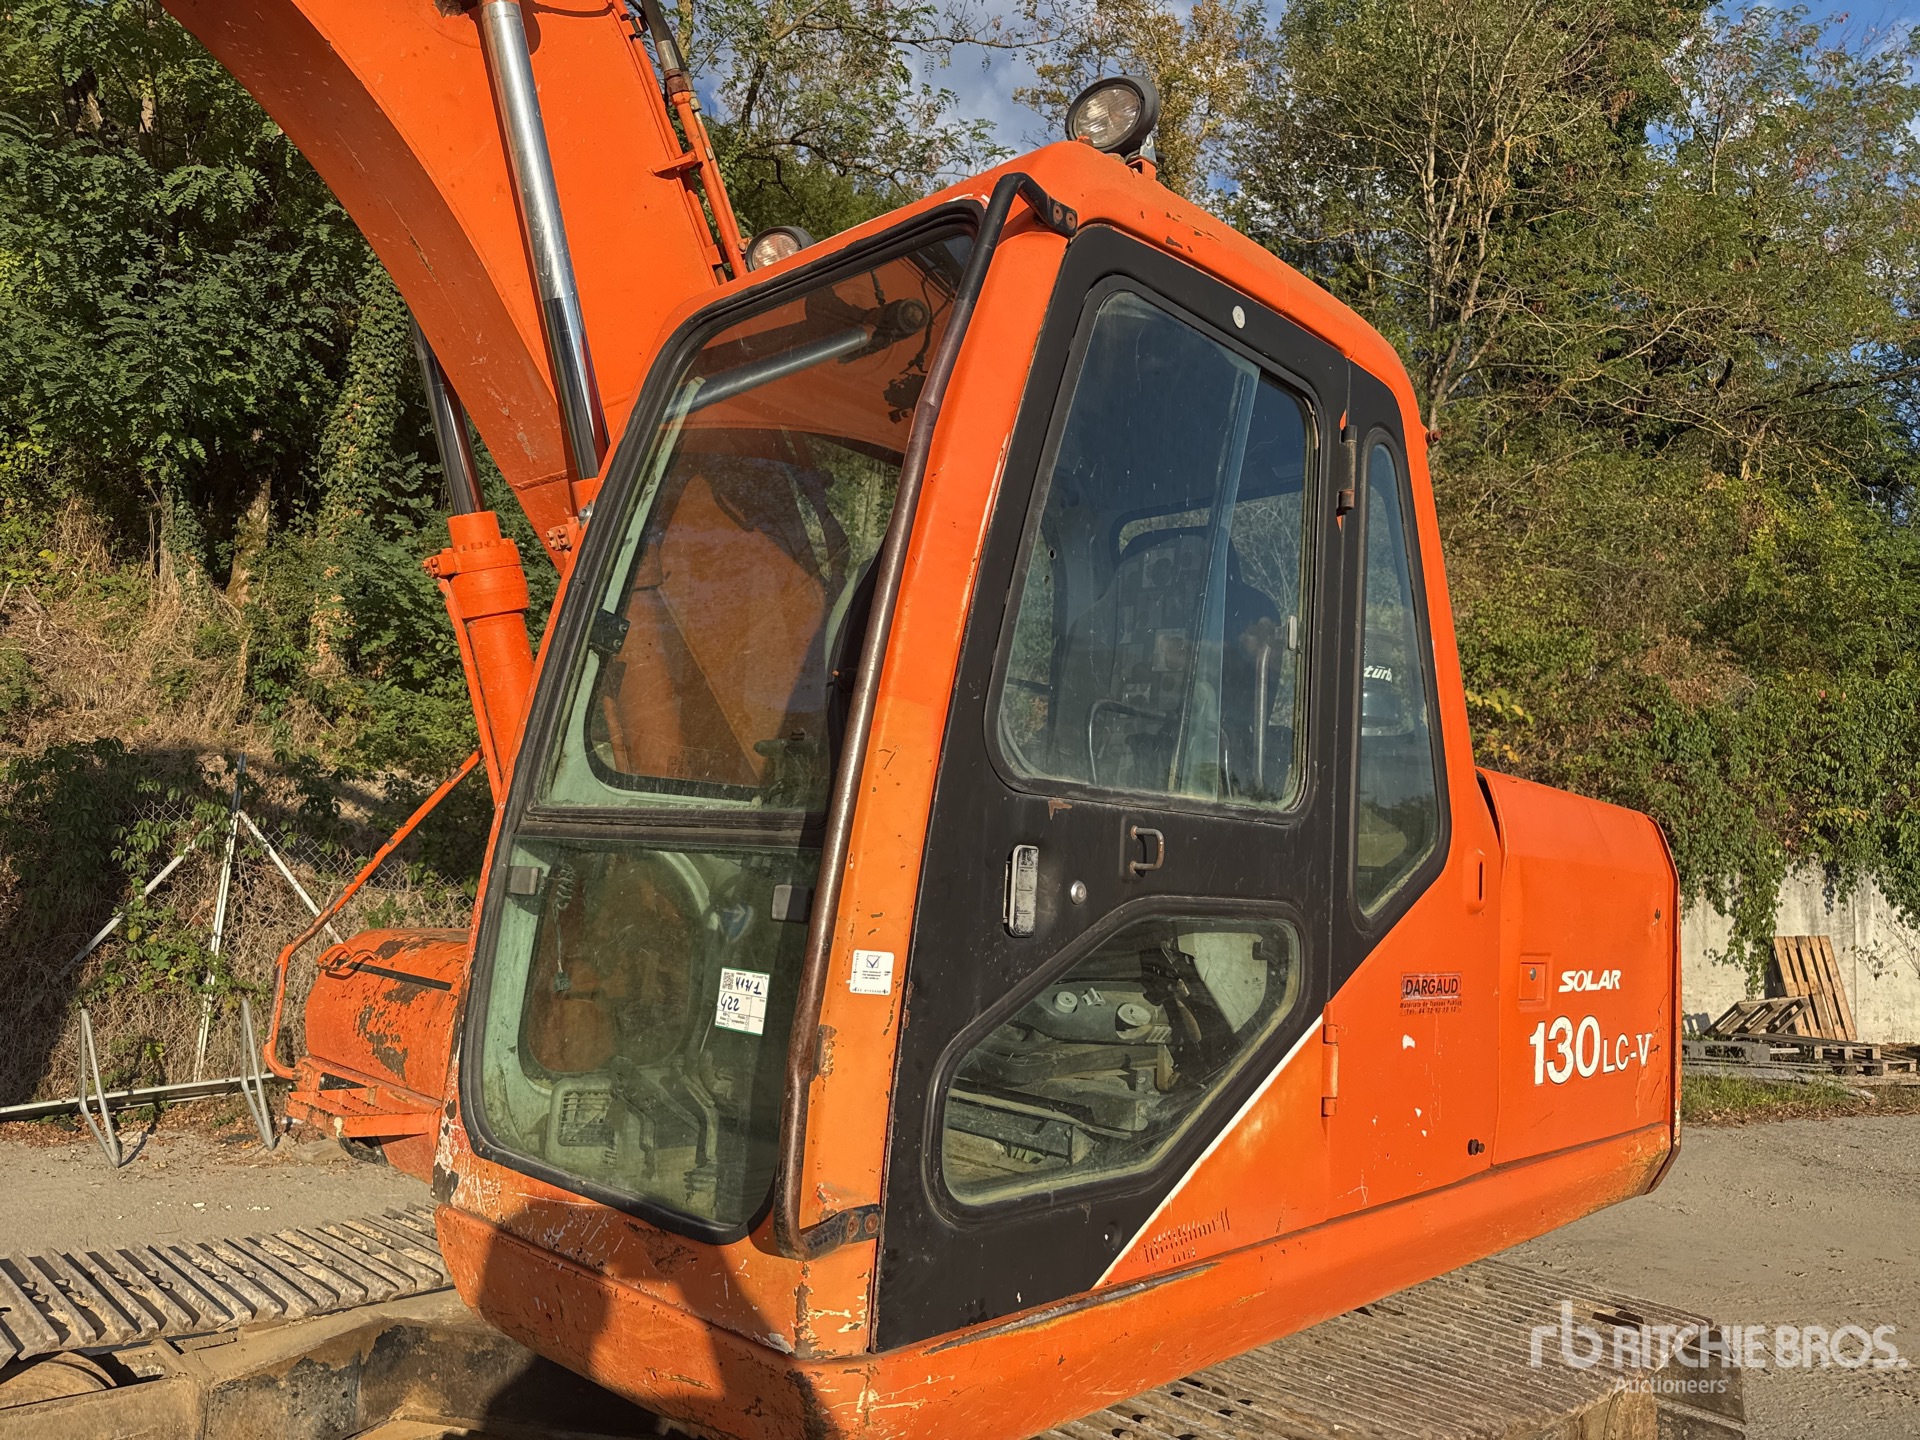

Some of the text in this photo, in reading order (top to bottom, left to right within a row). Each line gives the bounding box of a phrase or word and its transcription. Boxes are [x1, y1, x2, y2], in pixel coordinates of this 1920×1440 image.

[1405, 978, 1459, 995] DARGAUD
[1558, 969, 1622, 993] SOLAR
[720, 993, 740, 1012] 422
